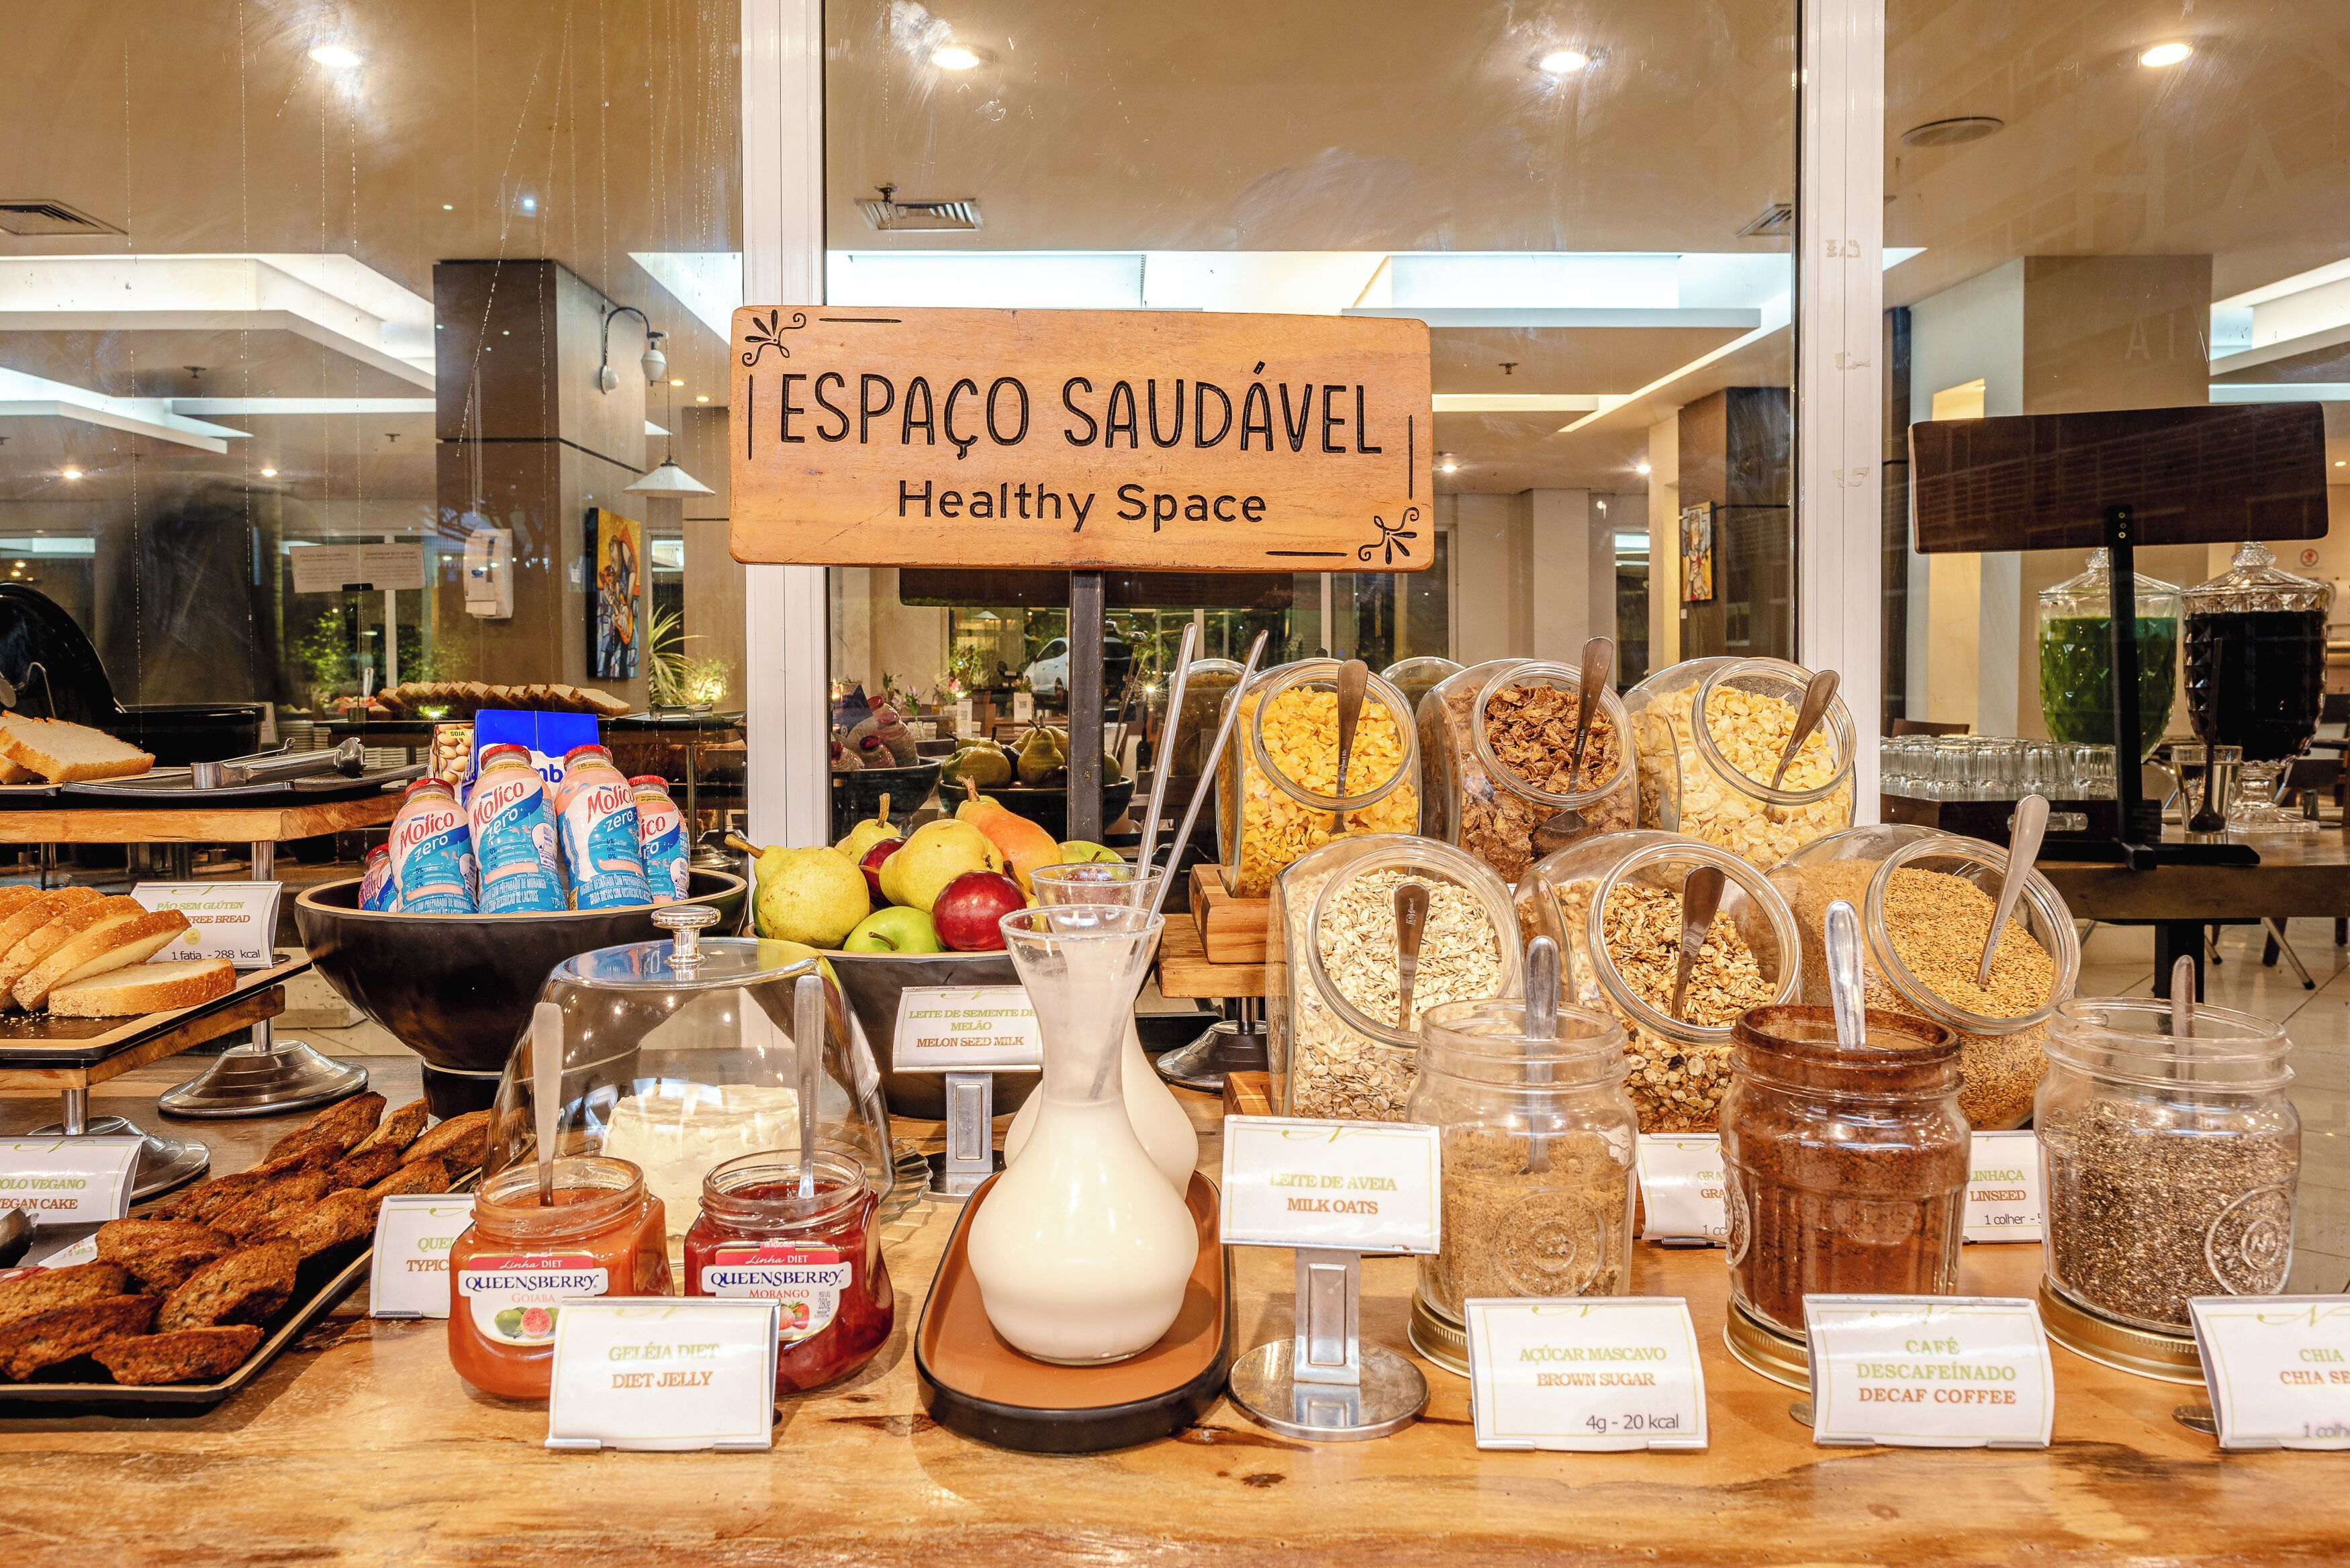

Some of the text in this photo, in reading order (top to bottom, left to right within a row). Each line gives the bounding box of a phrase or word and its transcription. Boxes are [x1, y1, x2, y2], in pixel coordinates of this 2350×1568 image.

[780, 361, 1382, 460] ESPAÇO SAUDÁVEL
[899, 479, 1267, 533] Healthy Space
[473, 782, 524, 838] Molico
[588, 785, 634, 824] Molico
[485, 807, 518, 844] zero
[606, 810, 633, 833] zero
[641, 816, 665, 840] ico
[399, 812, 455, 859] Molico
[413, 834, 449, 862] zero
[489, 846, 498, 854] 0%
[643, 842, 659, 860] ro
[156, 900, 245, 910] PÃO SEM GLÚTEN
[215, 915, 250, 924] BREAD
[172, 952, 177, 961] 1
[180, 950, 201, 960] fatia
[215, 950, 235, 959] 288
[240, 950, 261, 959] kcal
[908, 1008, 1036, 1018] LEITE DE SEMENTE DE
[950, 1020, 992, 1030] MELÃO
[916, 1036, 1024, 1048] MELON SEED MILK
[0, 1179, 86, 1189] OLO VEGANO
[1269, 1174, 1398, 1191] LEITE DE AVEIA
[1969, 1189, 2026, 1202] LINSEED
[0, 1198, 78, 1210] EGAN CAKE
[1287, 1197, 1379, 1214] MILK OATS
[1985, 1214, 1991, 1225] 1
[1994, 1214, 2025, 1225] colher
[1703, 1224, 1709, 1235] 1
[406, 1259, 449, 1271] TYPIC
[499, 1260, 563, 1269] Linha DIET
[745, 1255, 808, 1265] Linha DIET
[466, 1275, 600, 1292] QUEENSBERRY
[710, 1269, 844, 1287] QUEENSBERRY
[512, 1293, 555, 1303] GOIABA
[749, 1289, 810, 1298] MORANGO
[818, 1297, 831, 1312] 280g
[608, 1341, 720, 1361] GELÉIA DIET
[1905, 1336, 1960, 1355] CAFÉ
[1519, 1344, 1666, 1365] AÇÚCAR MASCAVO
[2299, 1349, 2345, 1362] CHIA
[1856, 1361, 2016, 1381] DESCAFEÍNADO
[2280, 1371, 2325, 1385] CHIA
[611, 1371, 713, 1389] DIET JELLY
[1537, 1373, 1656, 1386] BROWN SUGAR
[1859, 1387, 2016, 1405] DECAF COFFEE
[1585, 1414, 1607, 1433] 4g
[1624, 1414, 1644, 1430] 20
[1649, 1414, 1679, 1429] kcal
[2303, 1423, 2310, 1438] 1
